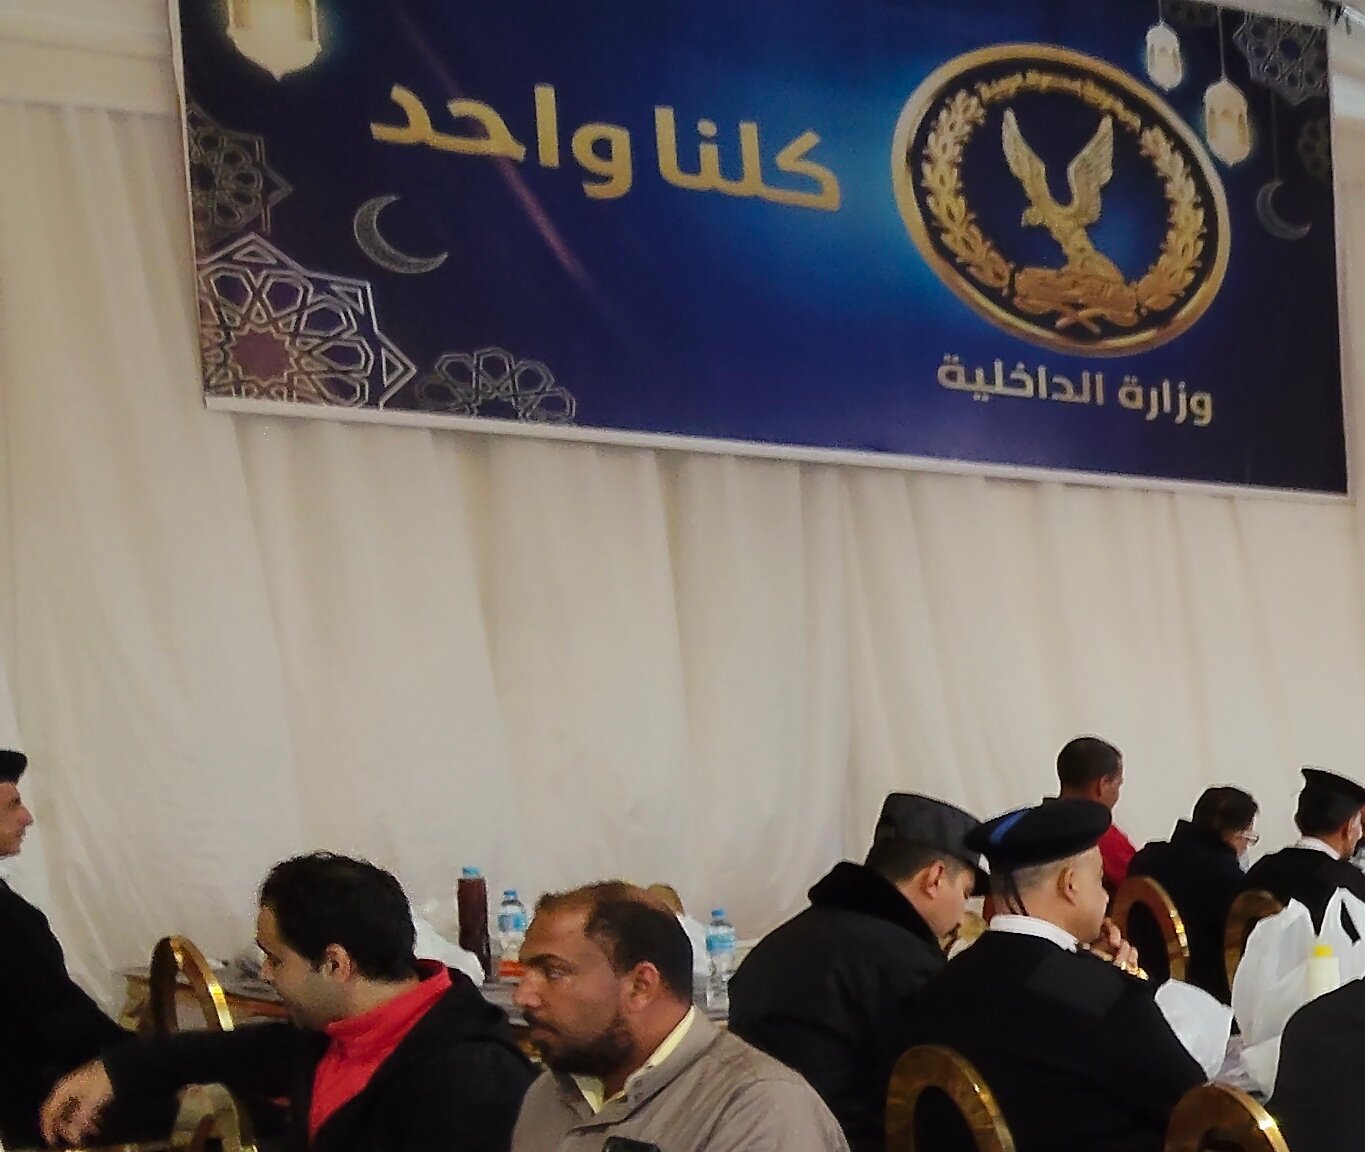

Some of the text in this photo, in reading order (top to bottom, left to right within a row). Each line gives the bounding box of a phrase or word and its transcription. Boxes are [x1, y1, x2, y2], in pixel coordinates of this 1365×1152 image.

[370, 83, 841, 213] كلنا واحد
[936, 352, 1213, 427] وزارة الداخلية
